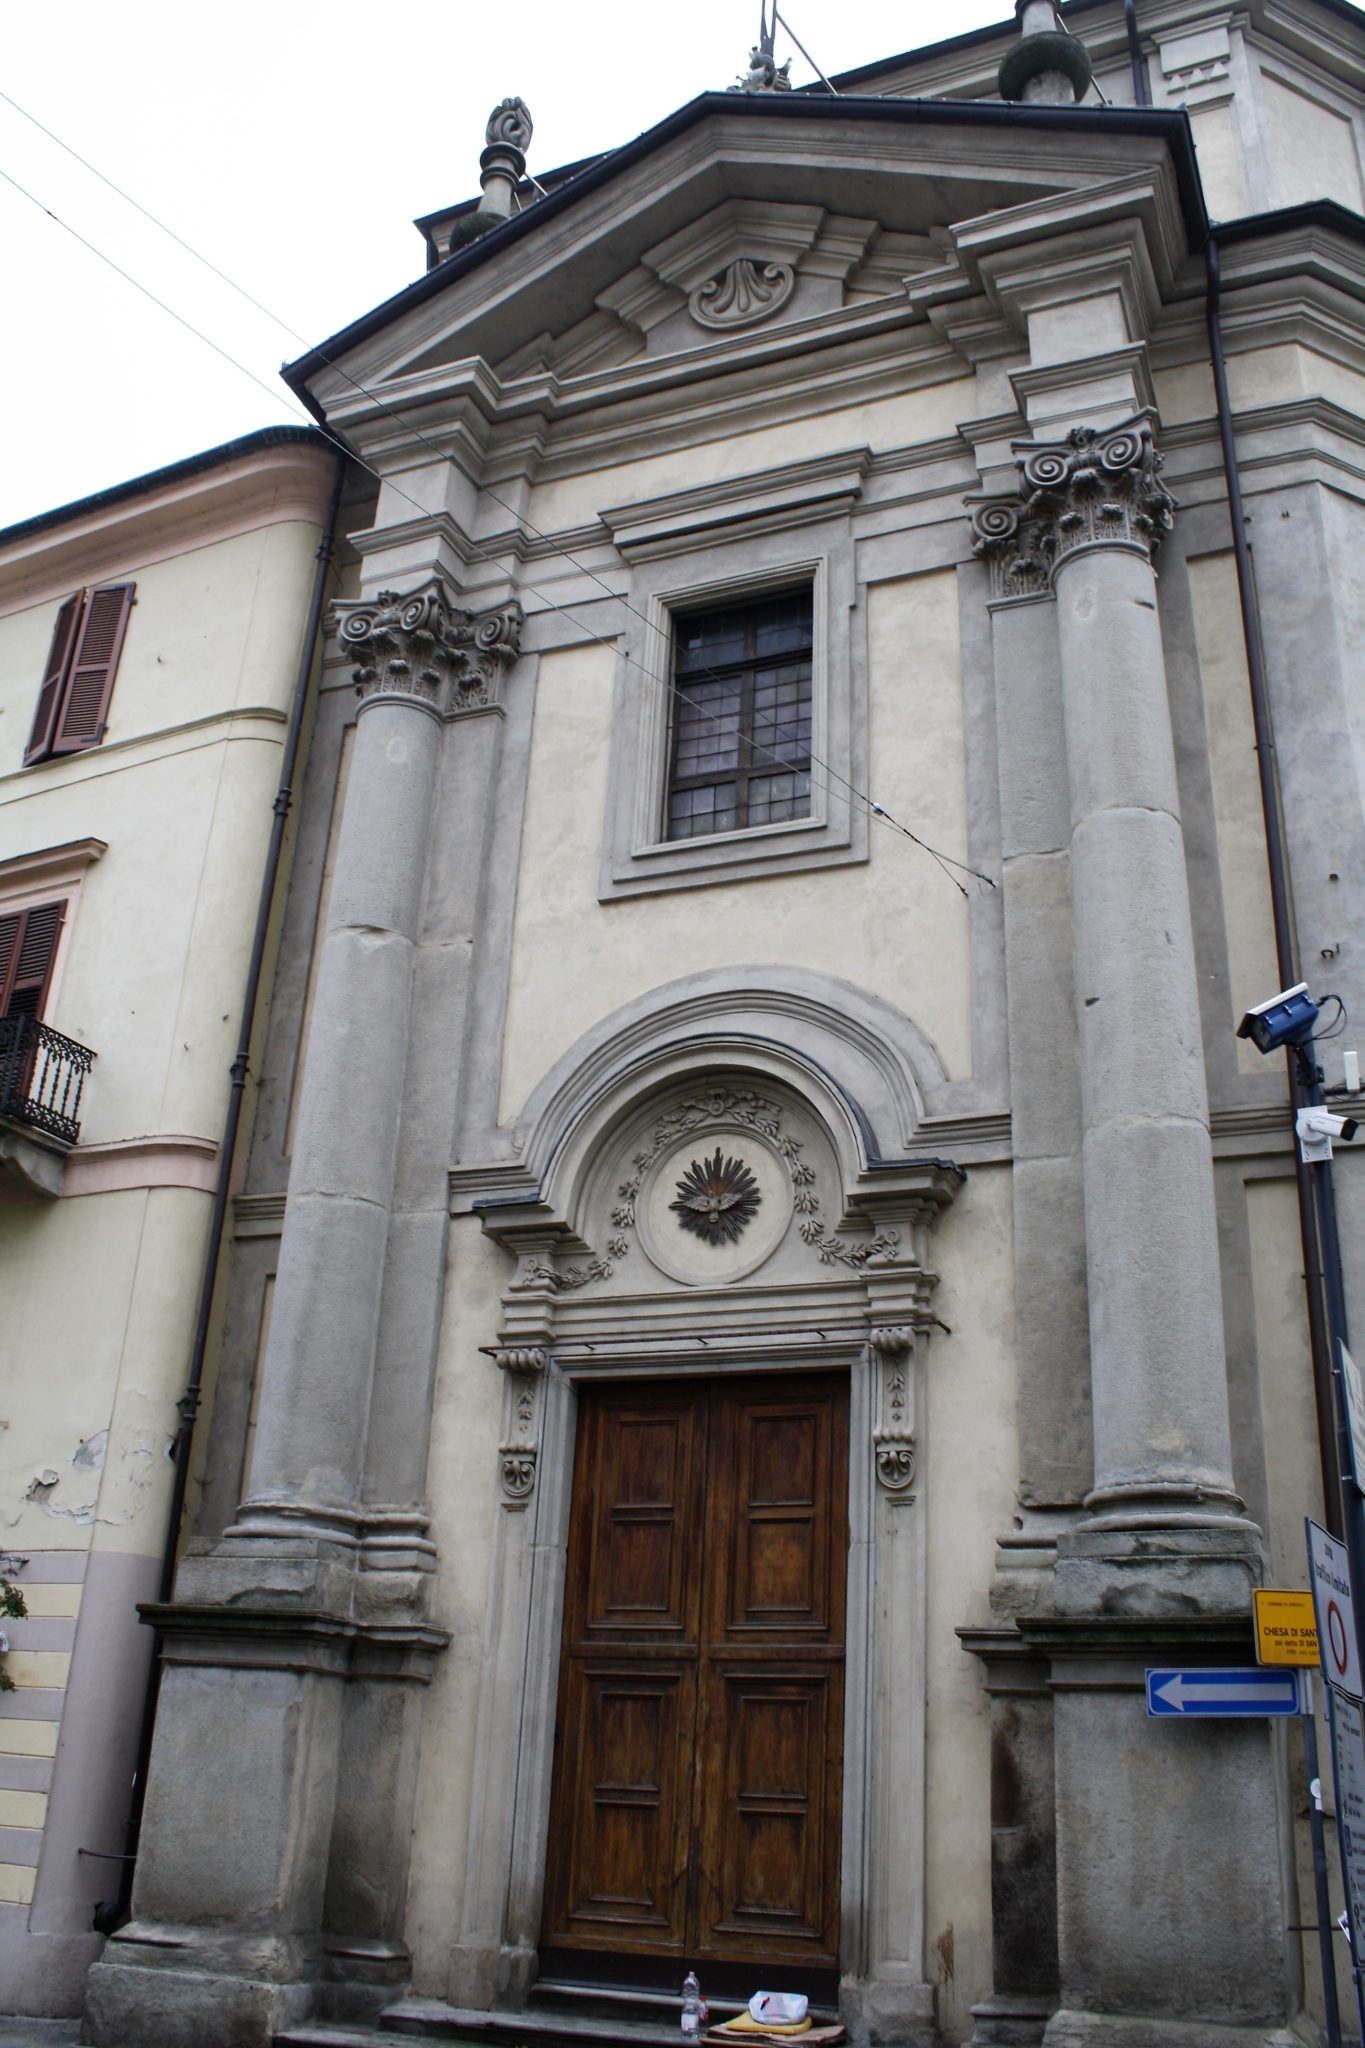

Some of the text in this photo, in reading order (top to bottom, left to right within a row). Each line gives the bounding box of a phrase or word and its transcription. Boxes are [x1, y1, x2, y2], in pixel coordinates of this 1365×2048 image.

[1331, 1570, 1350, 1597] limitato
[1264, 1627, 1288, 1636] CHIESA
[1291, 1628, 1298, 1637] DI
